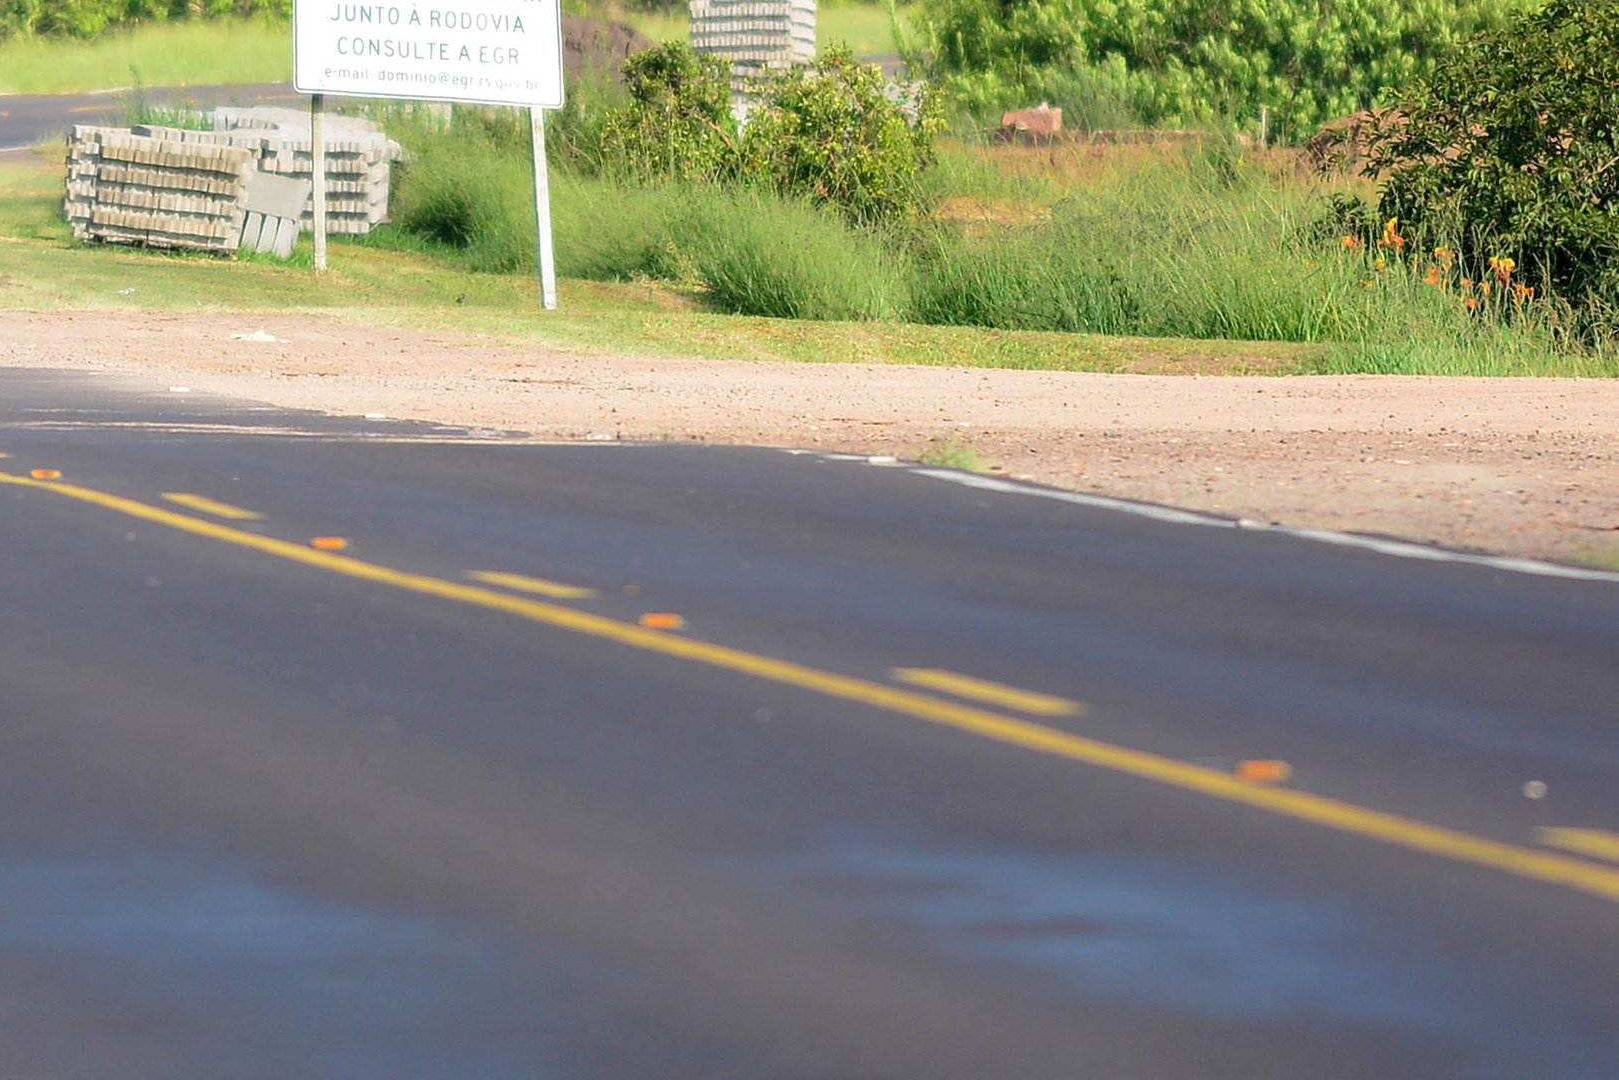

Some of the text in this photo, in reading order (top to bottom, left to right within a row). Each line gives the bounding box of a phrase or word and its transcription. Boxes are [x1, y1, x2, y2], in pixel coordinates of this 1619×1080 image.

[330, 3, 400, 26] JUNTO
[429, 10, 526, 33] RODOVIA
[337, 36, 520, 65] CONSULTE A EGR
[377, 69, 539, 91] dominio@egrrsgovbr
